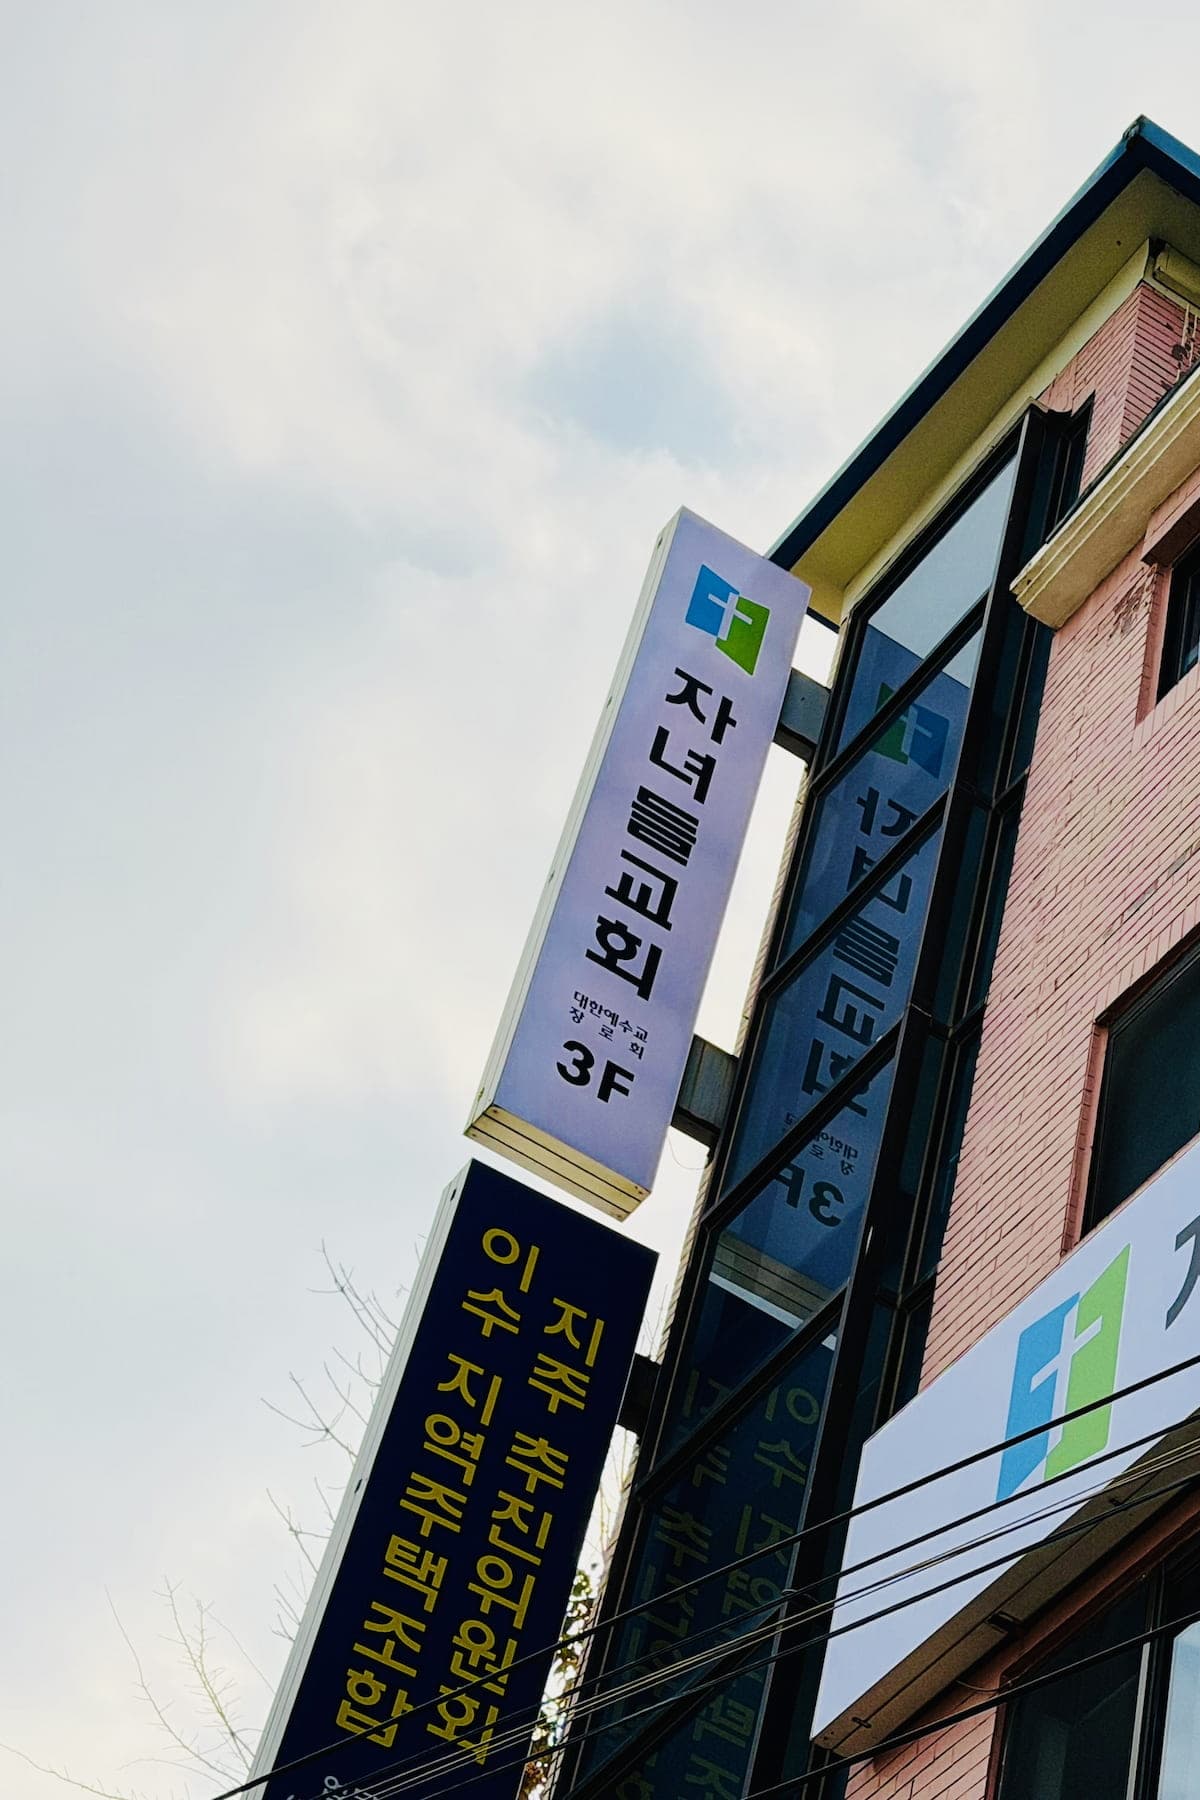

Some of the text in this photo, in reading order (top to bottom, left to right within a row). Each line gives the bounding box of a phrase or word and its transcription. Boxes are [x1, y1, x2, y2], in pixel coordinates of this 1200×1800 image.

[584, 666, 738, 1001] 자녀들교회
[556, 1040, 635, 1103] 3F
[573, 990, 649, 1043] 대한예수교
[461, 1226, 540, 1339] 이수
[335, 1352, 503, 1750] 지역주택조합
[425, 1296, 605, 1766] 지주 추진위원회
